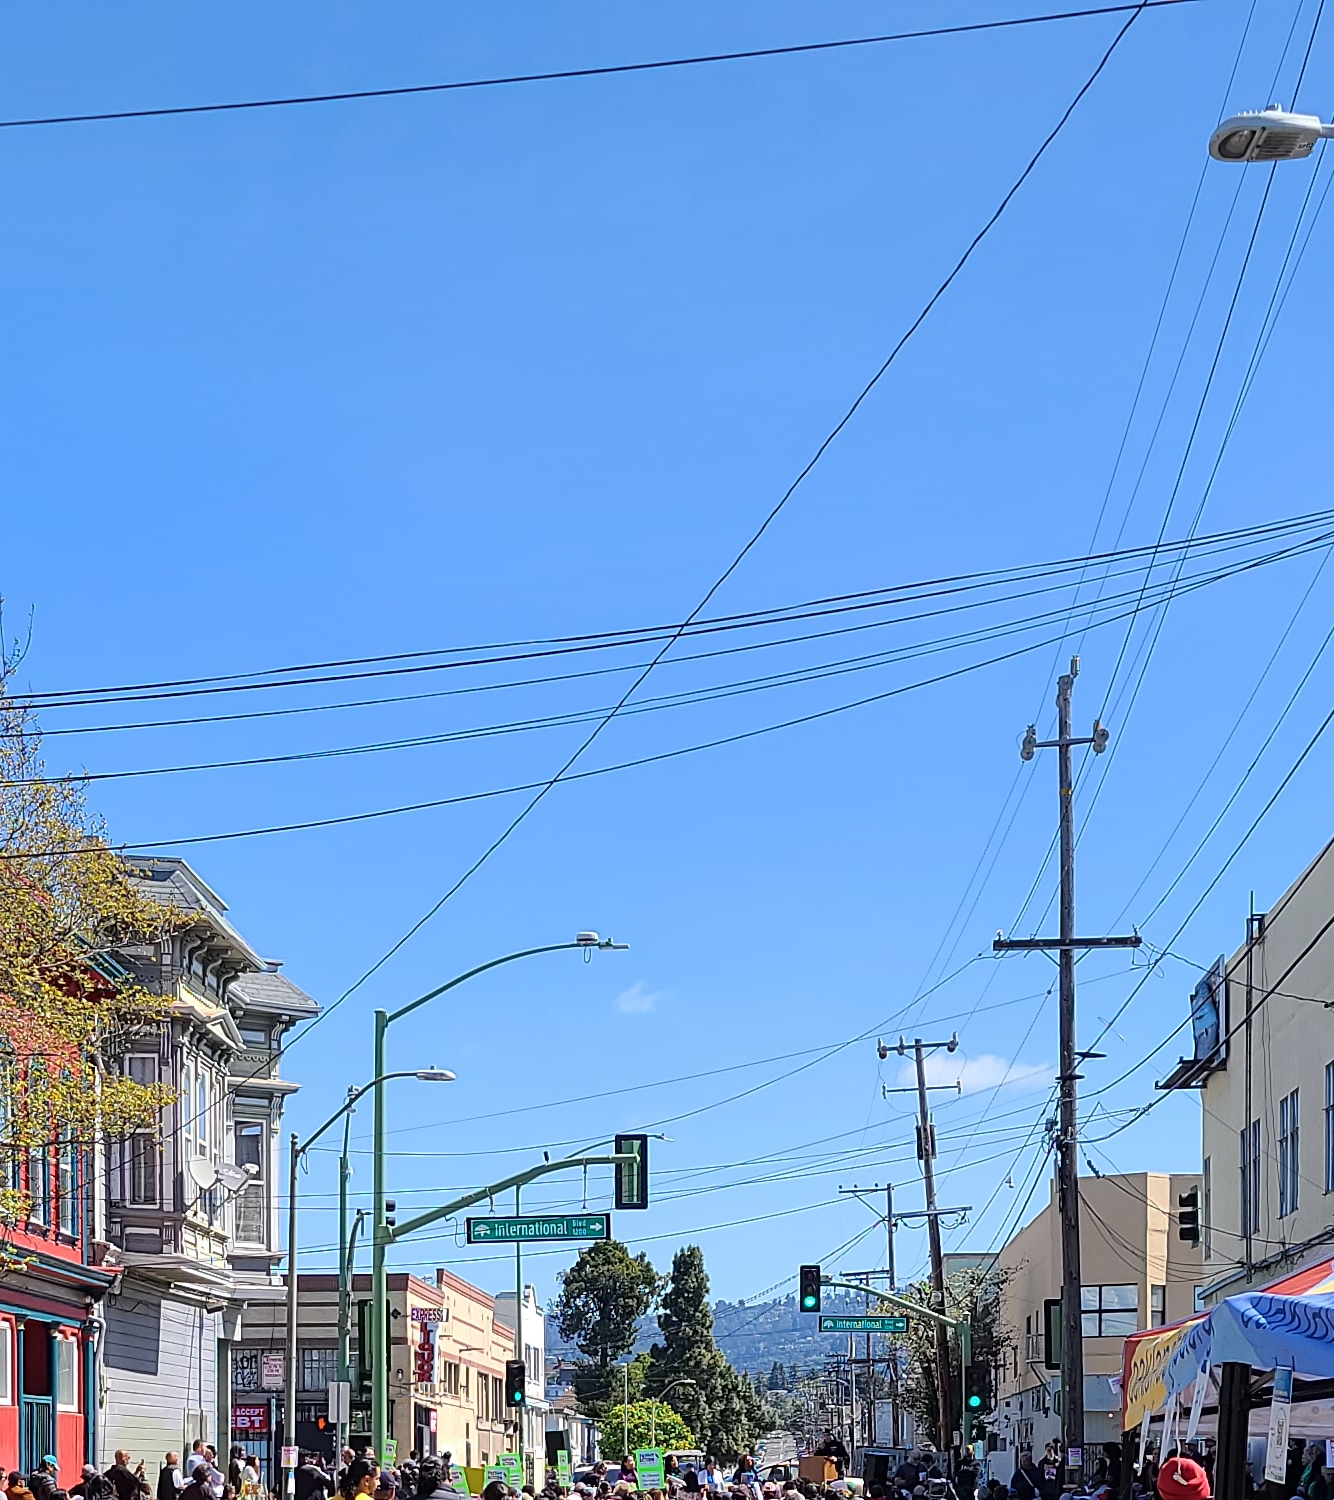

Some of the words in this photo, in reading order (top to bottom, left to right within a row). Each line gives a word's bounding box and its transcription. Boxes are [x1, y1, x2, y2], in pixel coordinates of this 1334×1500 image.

[572, 1219, 587, 1227] Blvd
[494, 1221, 567, 1237] International
[572, 1228, 587, 1236] 1200
[412, 1309, 442, 1322] EXPRESS
[836, 1319, 883, 1329] International
[418, 1321, 435, 1382] LIQUOR
[236, 1408, 265, 1416] ACCEPT
